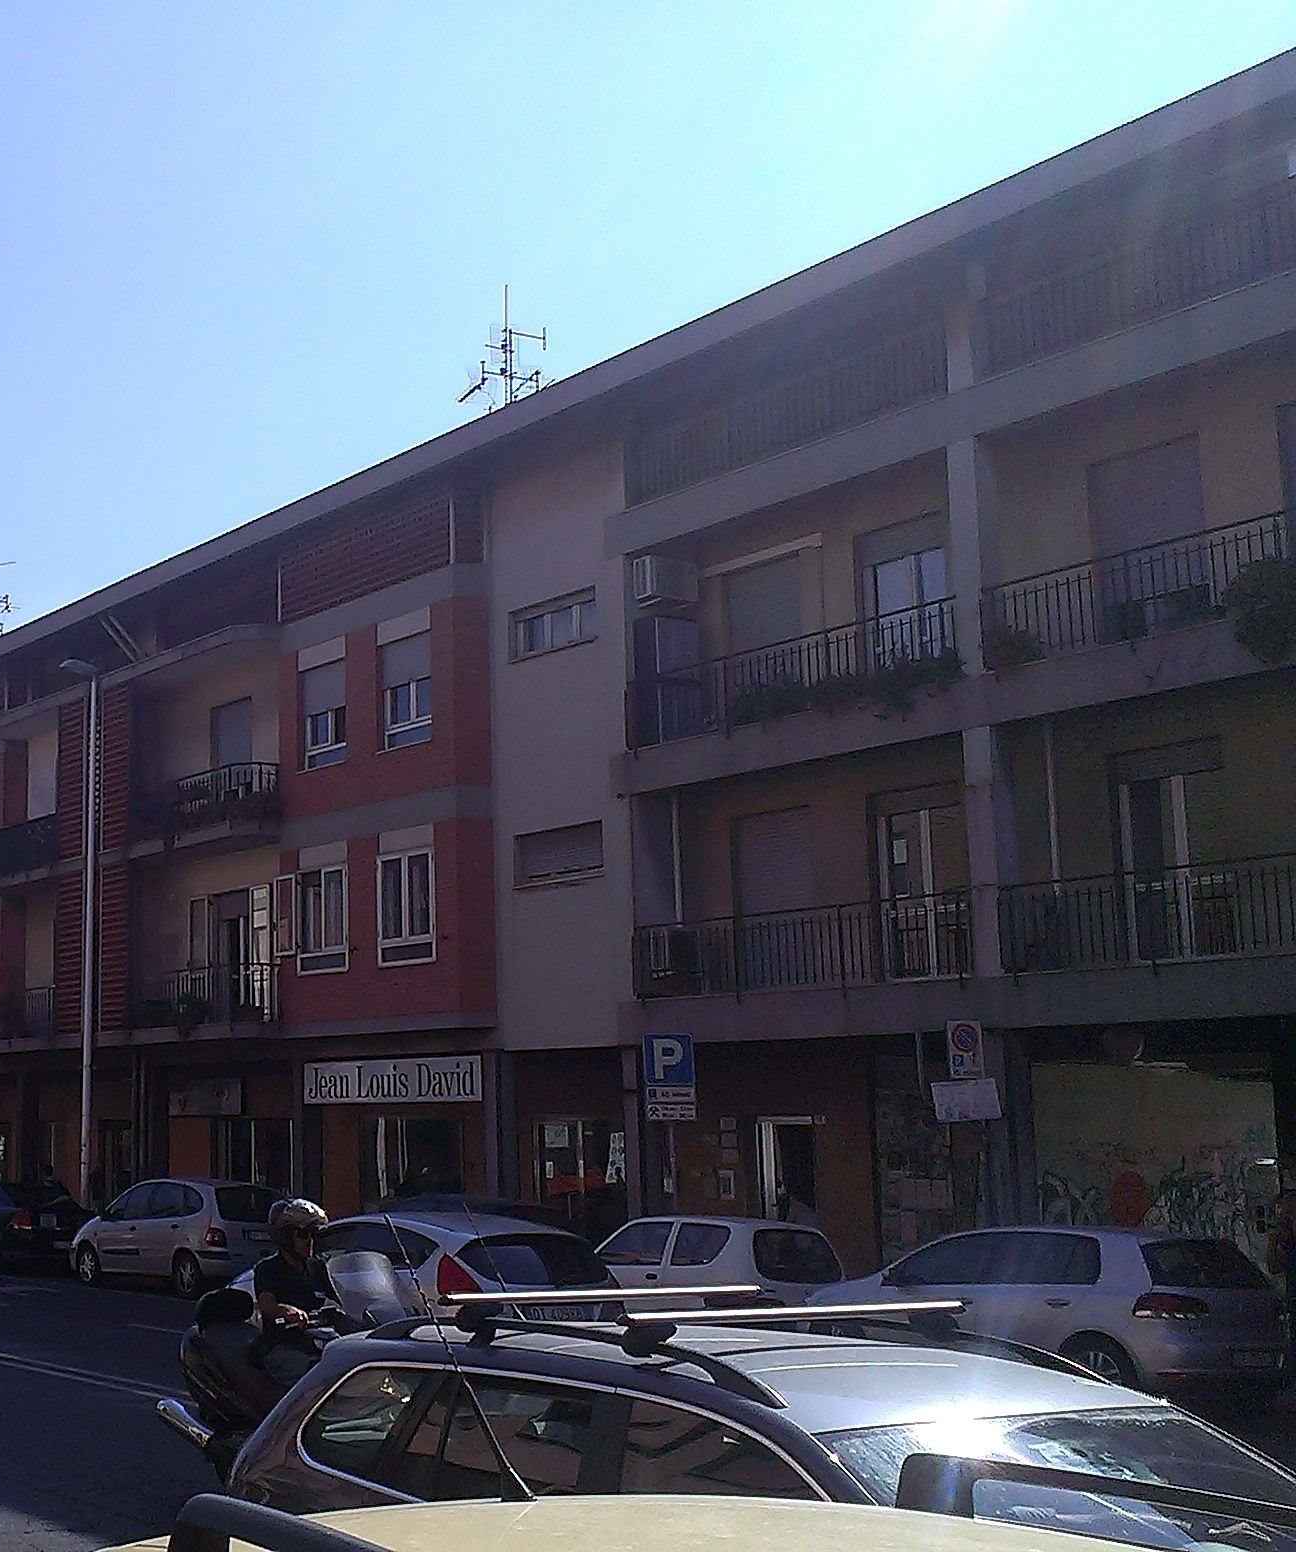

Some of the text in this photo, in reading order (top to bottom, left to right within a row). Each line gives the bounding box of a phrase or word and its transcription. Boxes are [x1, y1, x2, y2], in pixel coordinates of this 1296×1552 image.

[653, 1039, 683, 1079] P
[308, 1061, 475, 1100] Jean Louis David
